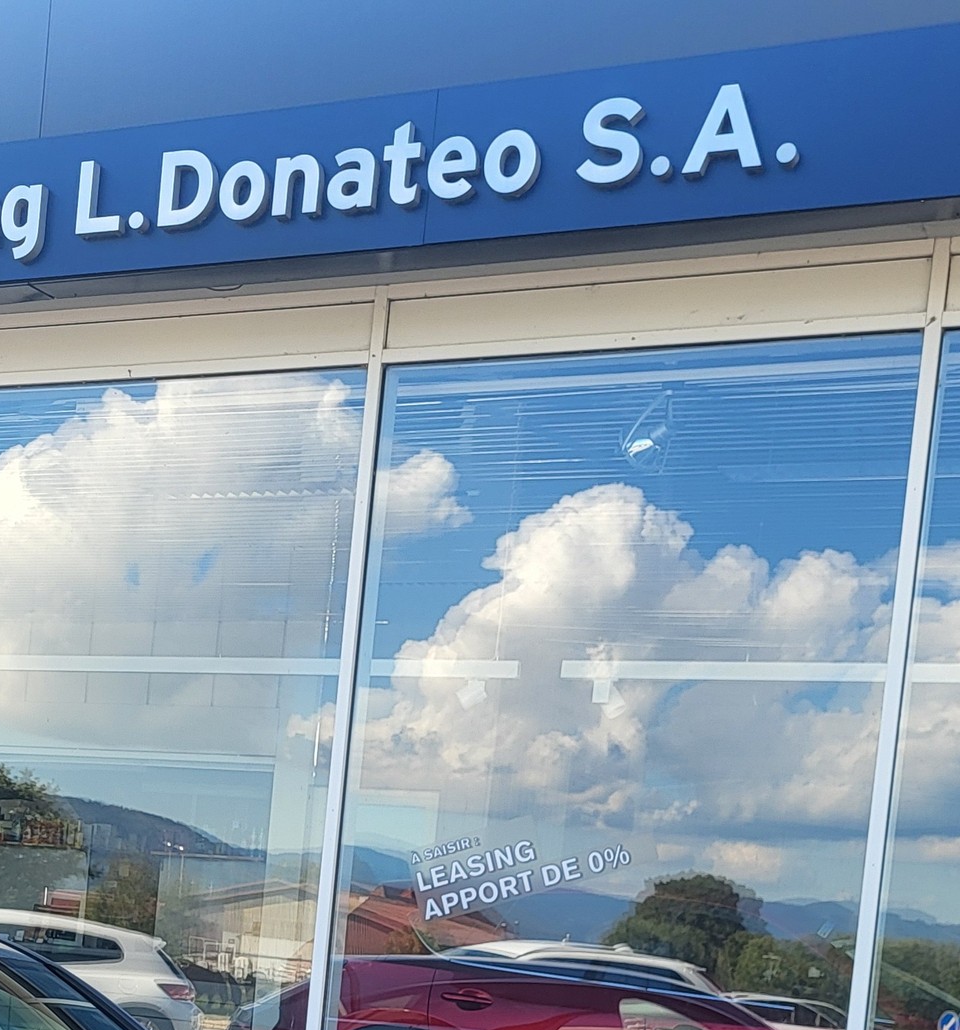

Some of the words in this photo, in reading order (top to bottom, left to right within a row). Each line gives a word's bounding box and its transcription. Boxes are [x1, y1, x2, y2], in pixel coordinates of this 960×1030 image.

[576, 83, 799, 186] S.A.
[416, 840, 536, 892] LEASING
[423, 838, 471, 861] SAISIR
[425, 870, 534, 921] APPORT
[541, 858, 582, 887] DE
[588, 844, 631, 873] 0%
